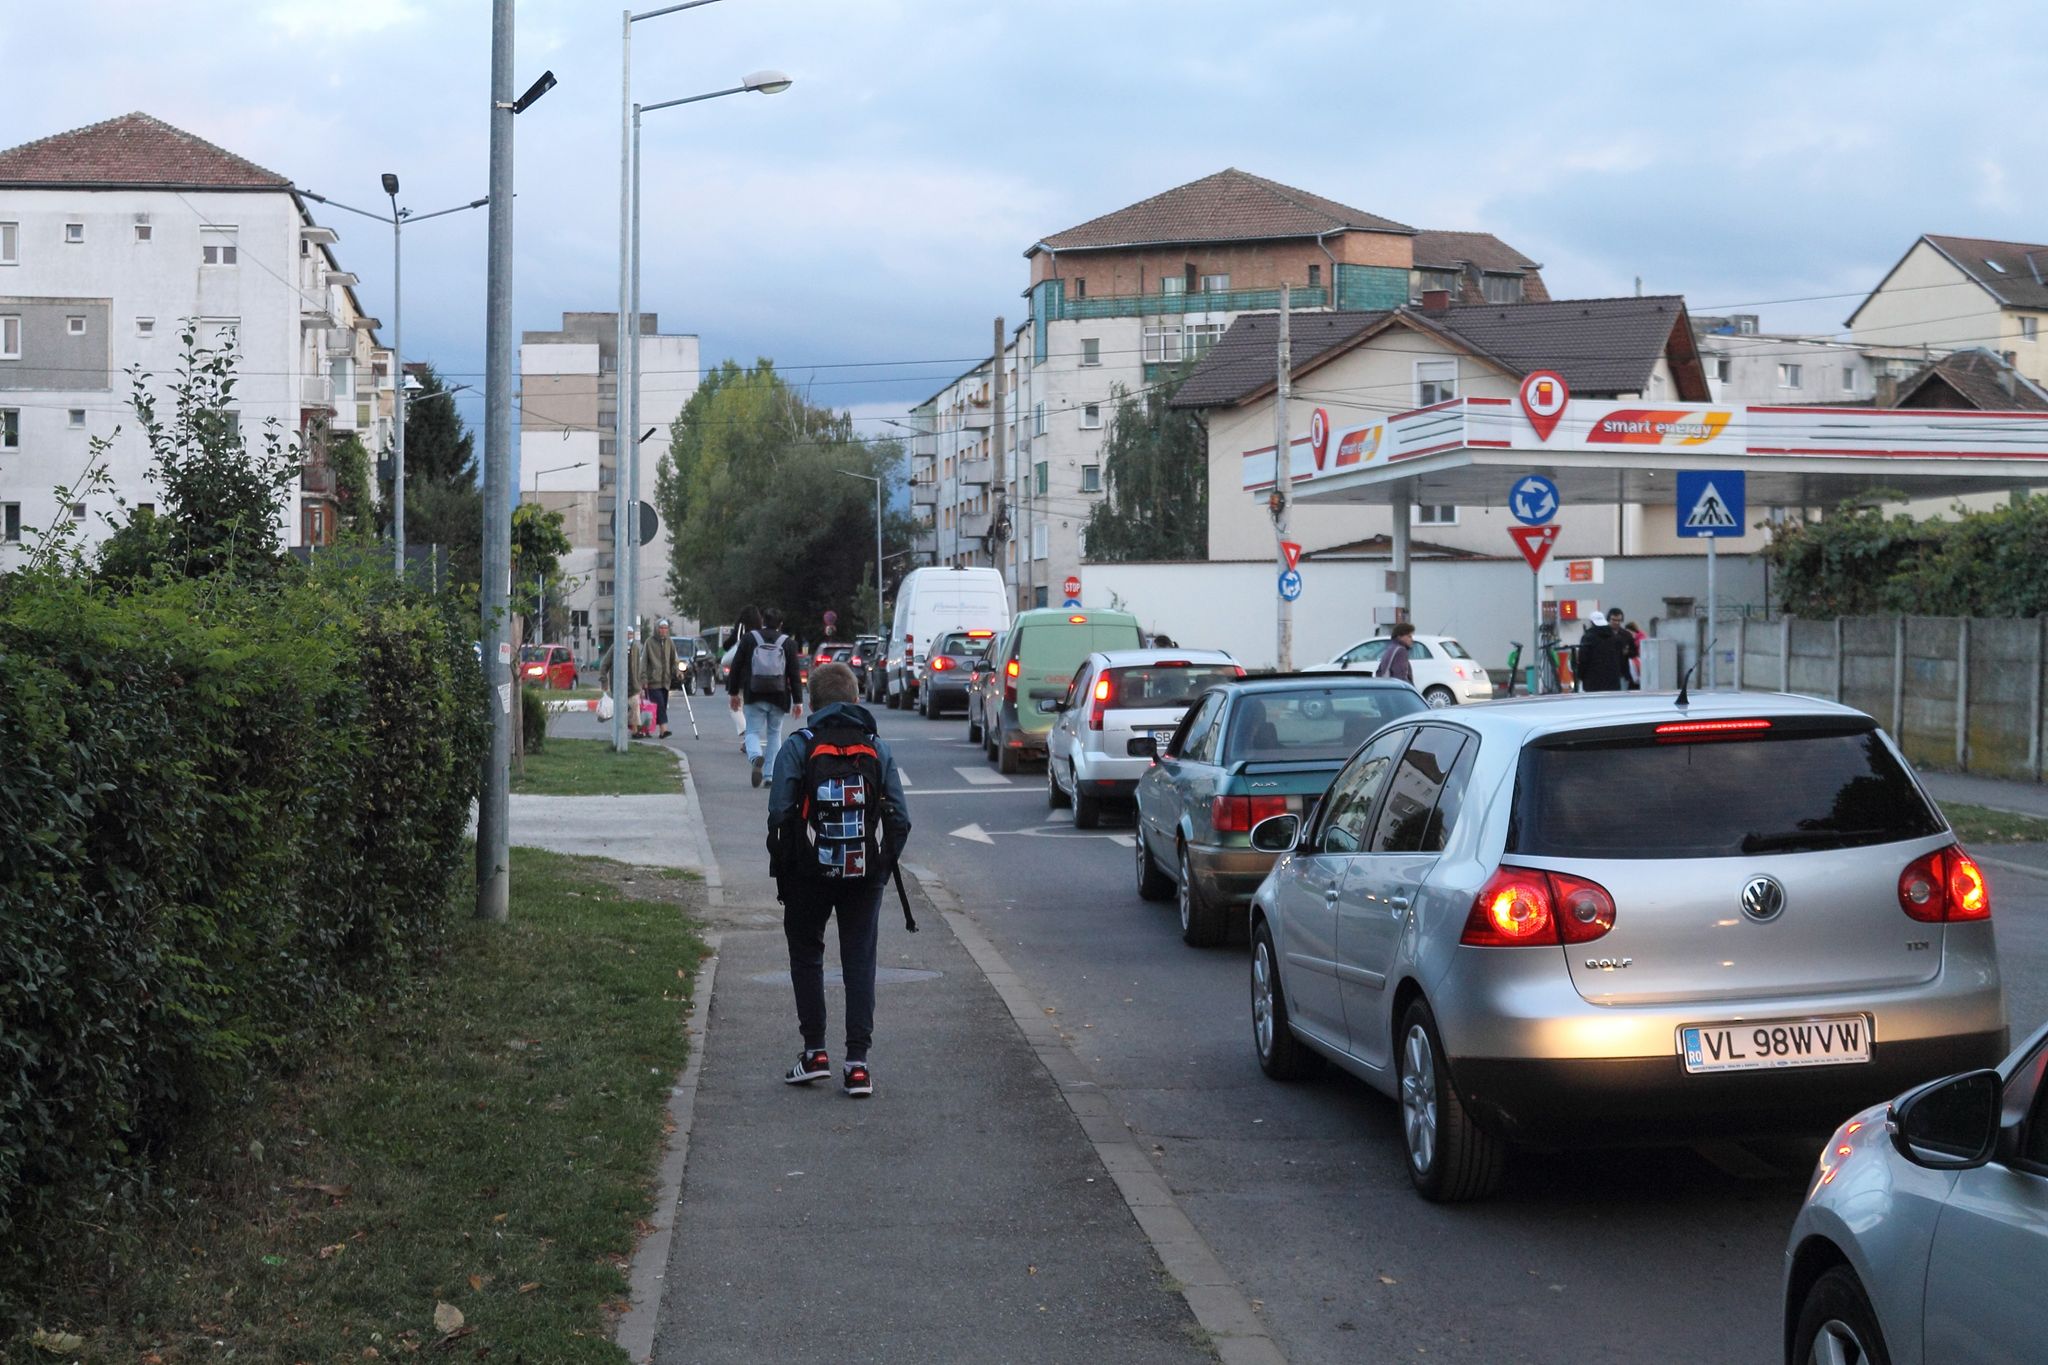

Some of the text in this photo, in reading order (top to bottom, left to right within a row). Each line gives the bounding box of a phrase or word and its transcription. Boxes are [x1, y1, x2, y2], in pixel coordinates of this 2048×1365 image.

[1603, 420, 1713, 440] smart energy
[1065, 582, 1080, 593] STOP
[1155, 732, 1171, 743] SB
[1585, 958, 1632, 969] GOLF
[1704, 1023, 1859, 1061] VL 98WVW
[1689, 1051, 1702, 1063] RO
